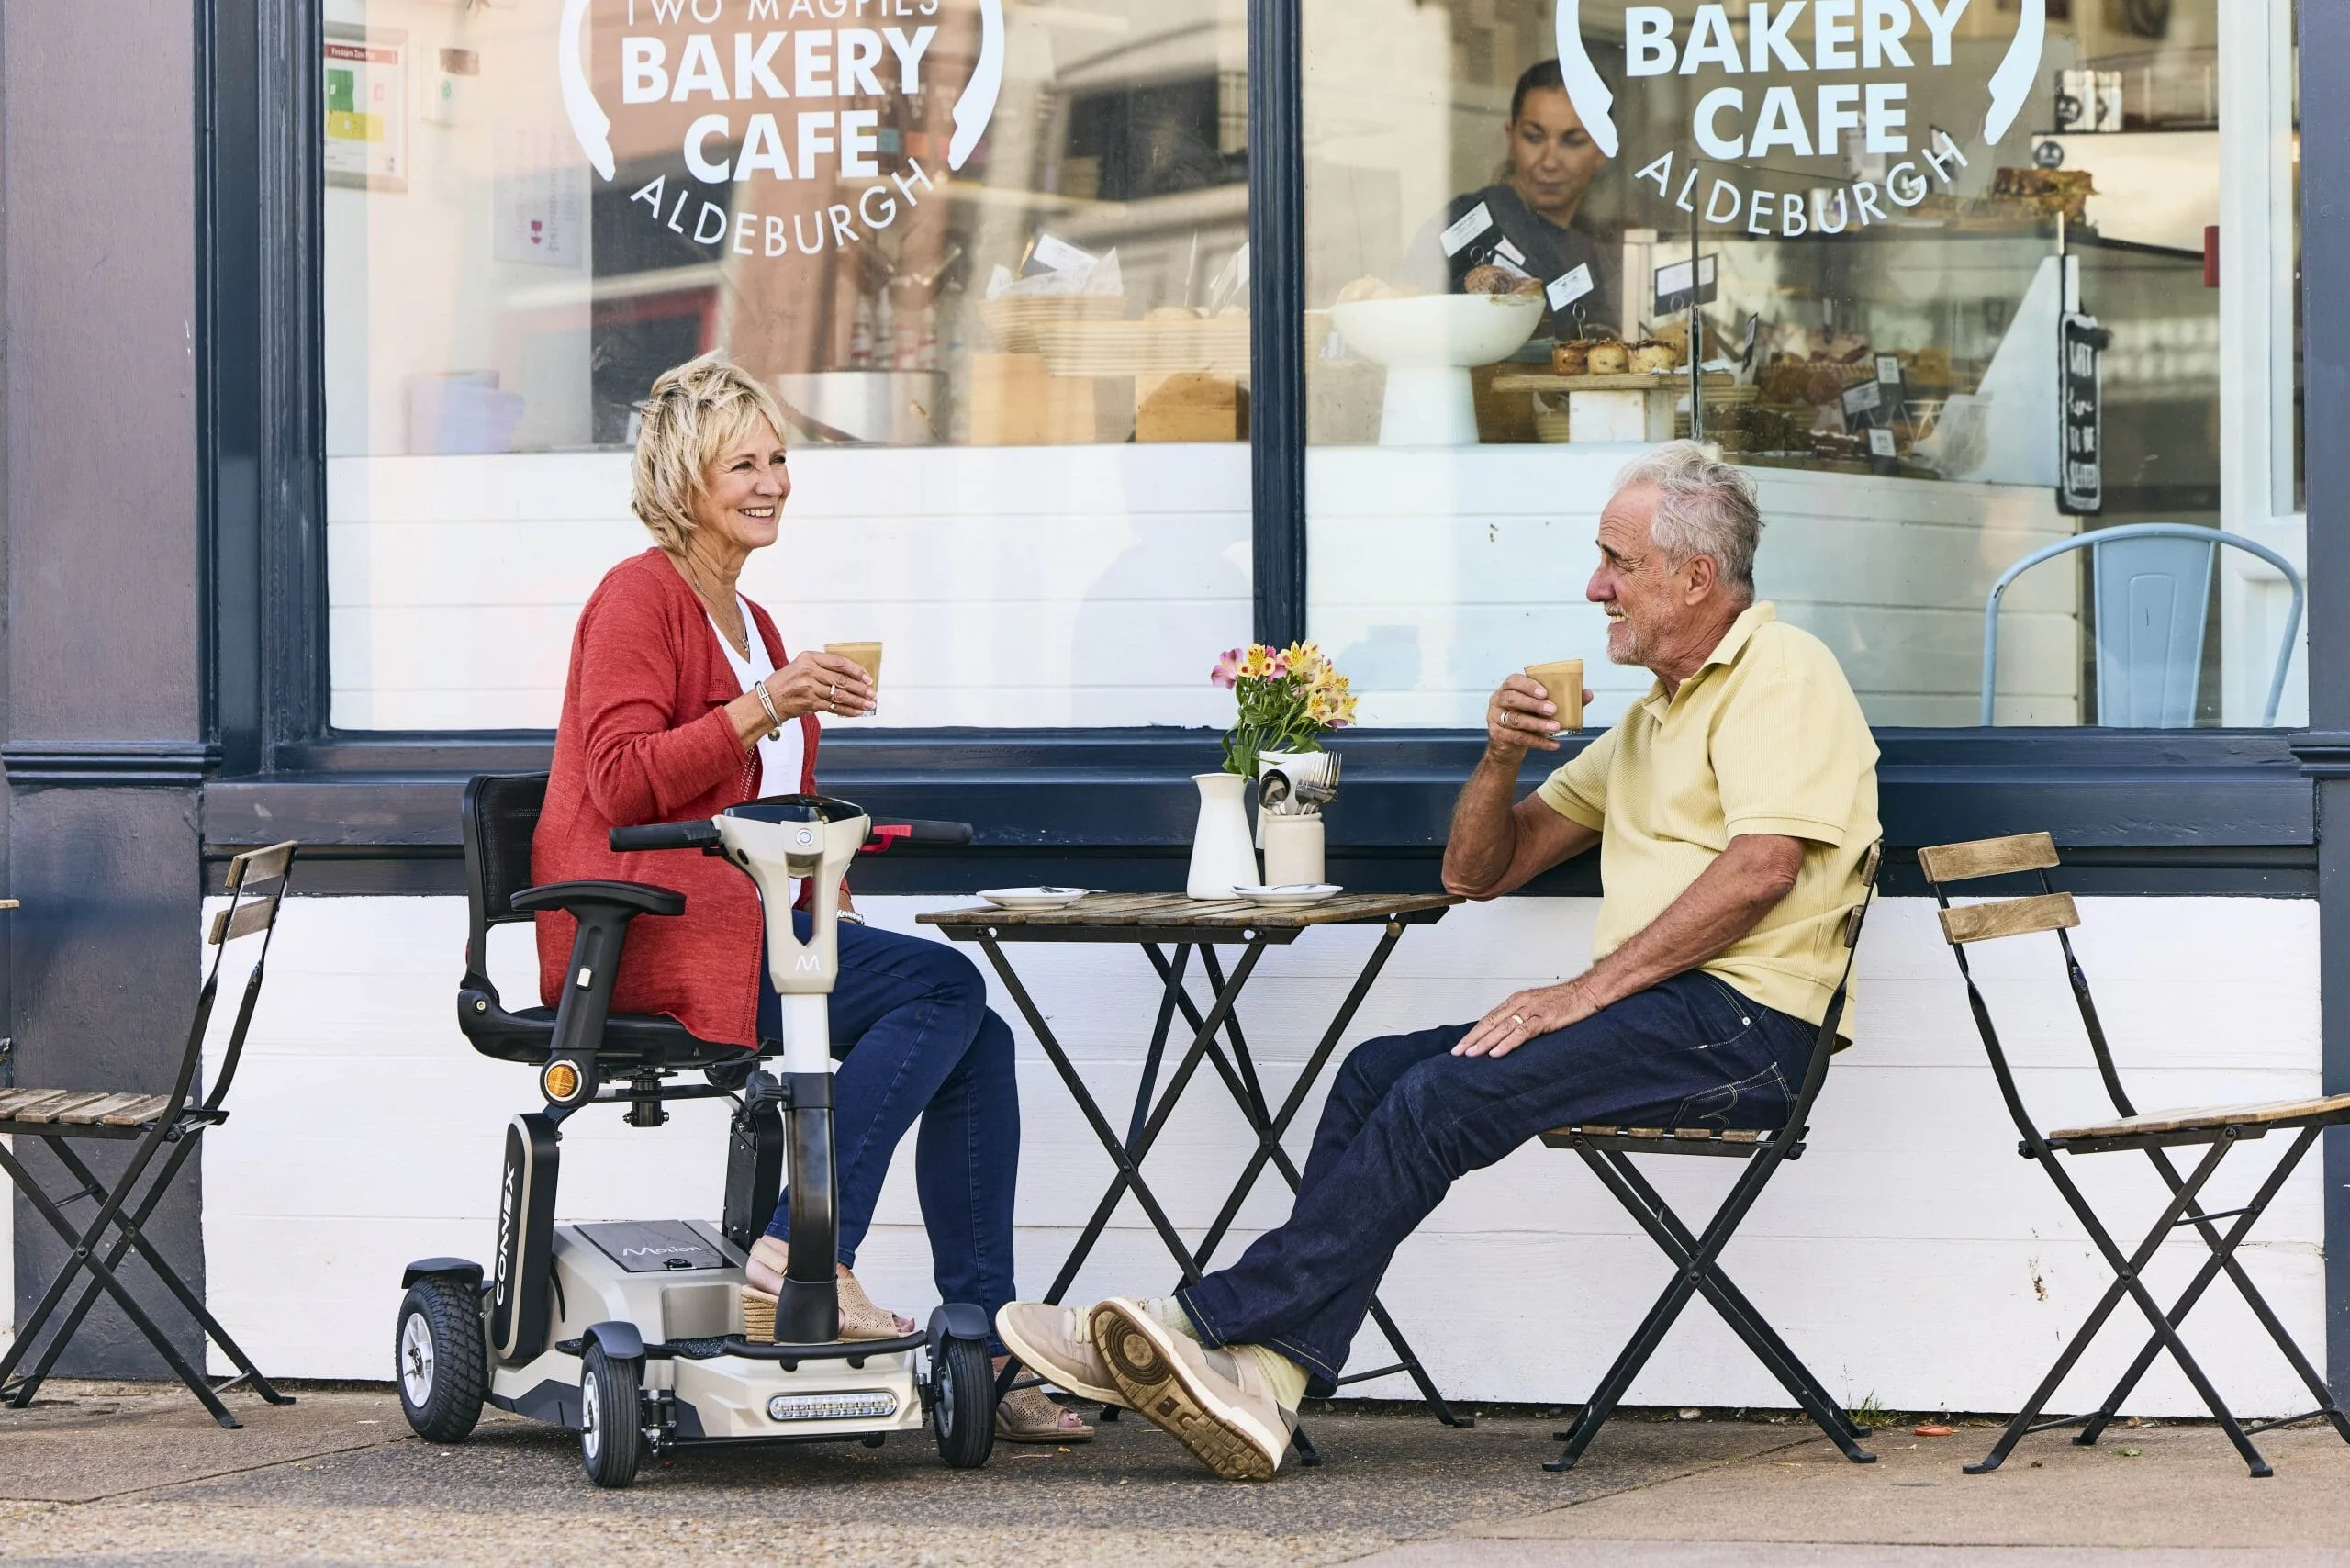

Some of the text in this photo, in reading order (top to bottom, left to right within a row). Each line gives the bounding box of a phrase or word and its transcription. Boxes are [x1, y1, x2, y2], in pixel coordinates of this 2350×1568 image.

[621, 26, 938, 104] BAKERY
[1625, 0, 1971, 77] BAKERY
[684, 109, 878, 184] CAFE
[1694, 83, 1908, 160] CAFE
[630, 157, 934, 257] ALDEBURGH
[1634, 131, 1968, 237] ALDEBURGH
[496, 1161, 515, 1306] CONNEX
[622, 1246, 702, 1257] Motion
